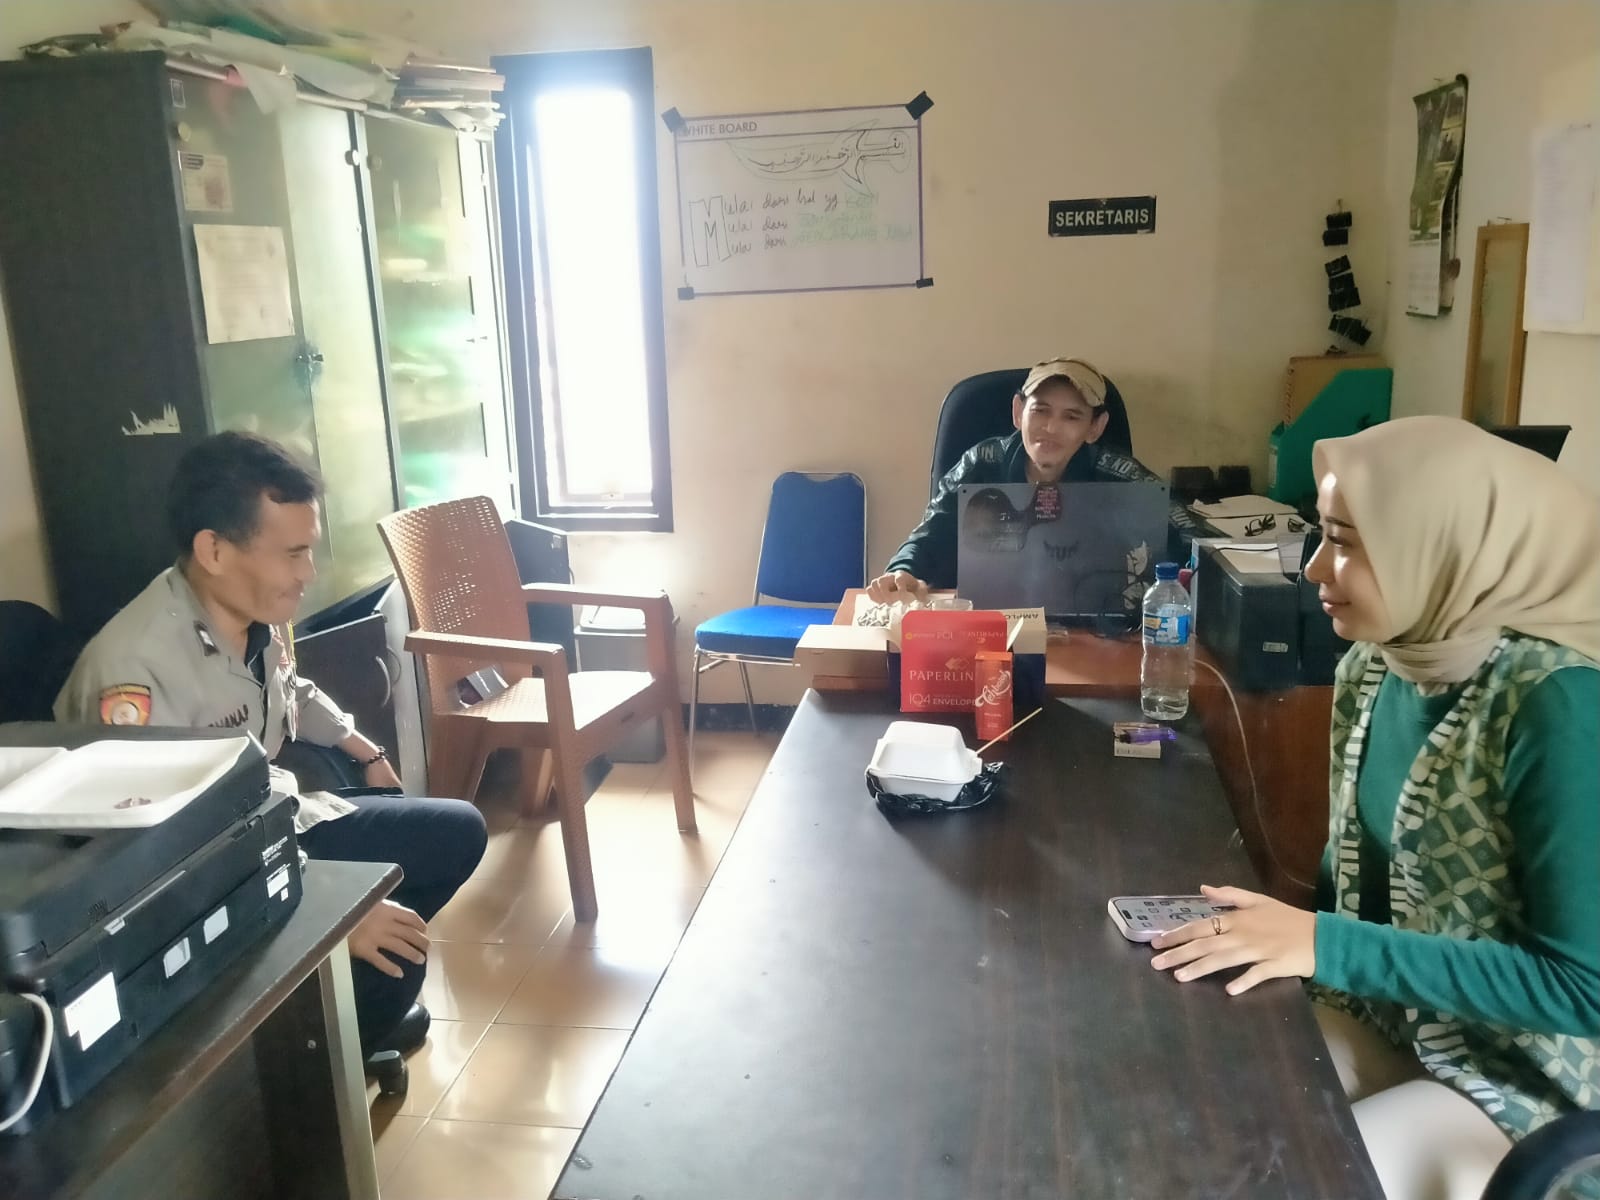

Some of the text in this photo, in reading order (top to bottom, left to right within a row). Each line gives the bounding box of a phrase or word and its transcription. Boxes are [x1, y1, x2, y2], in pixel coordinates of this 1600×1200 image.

[719, 120, 758, 135] BOARD
[1055, 208, 1149, 227] SEKRETARIS
[909, 669, 974, 681] PAPERLIN
